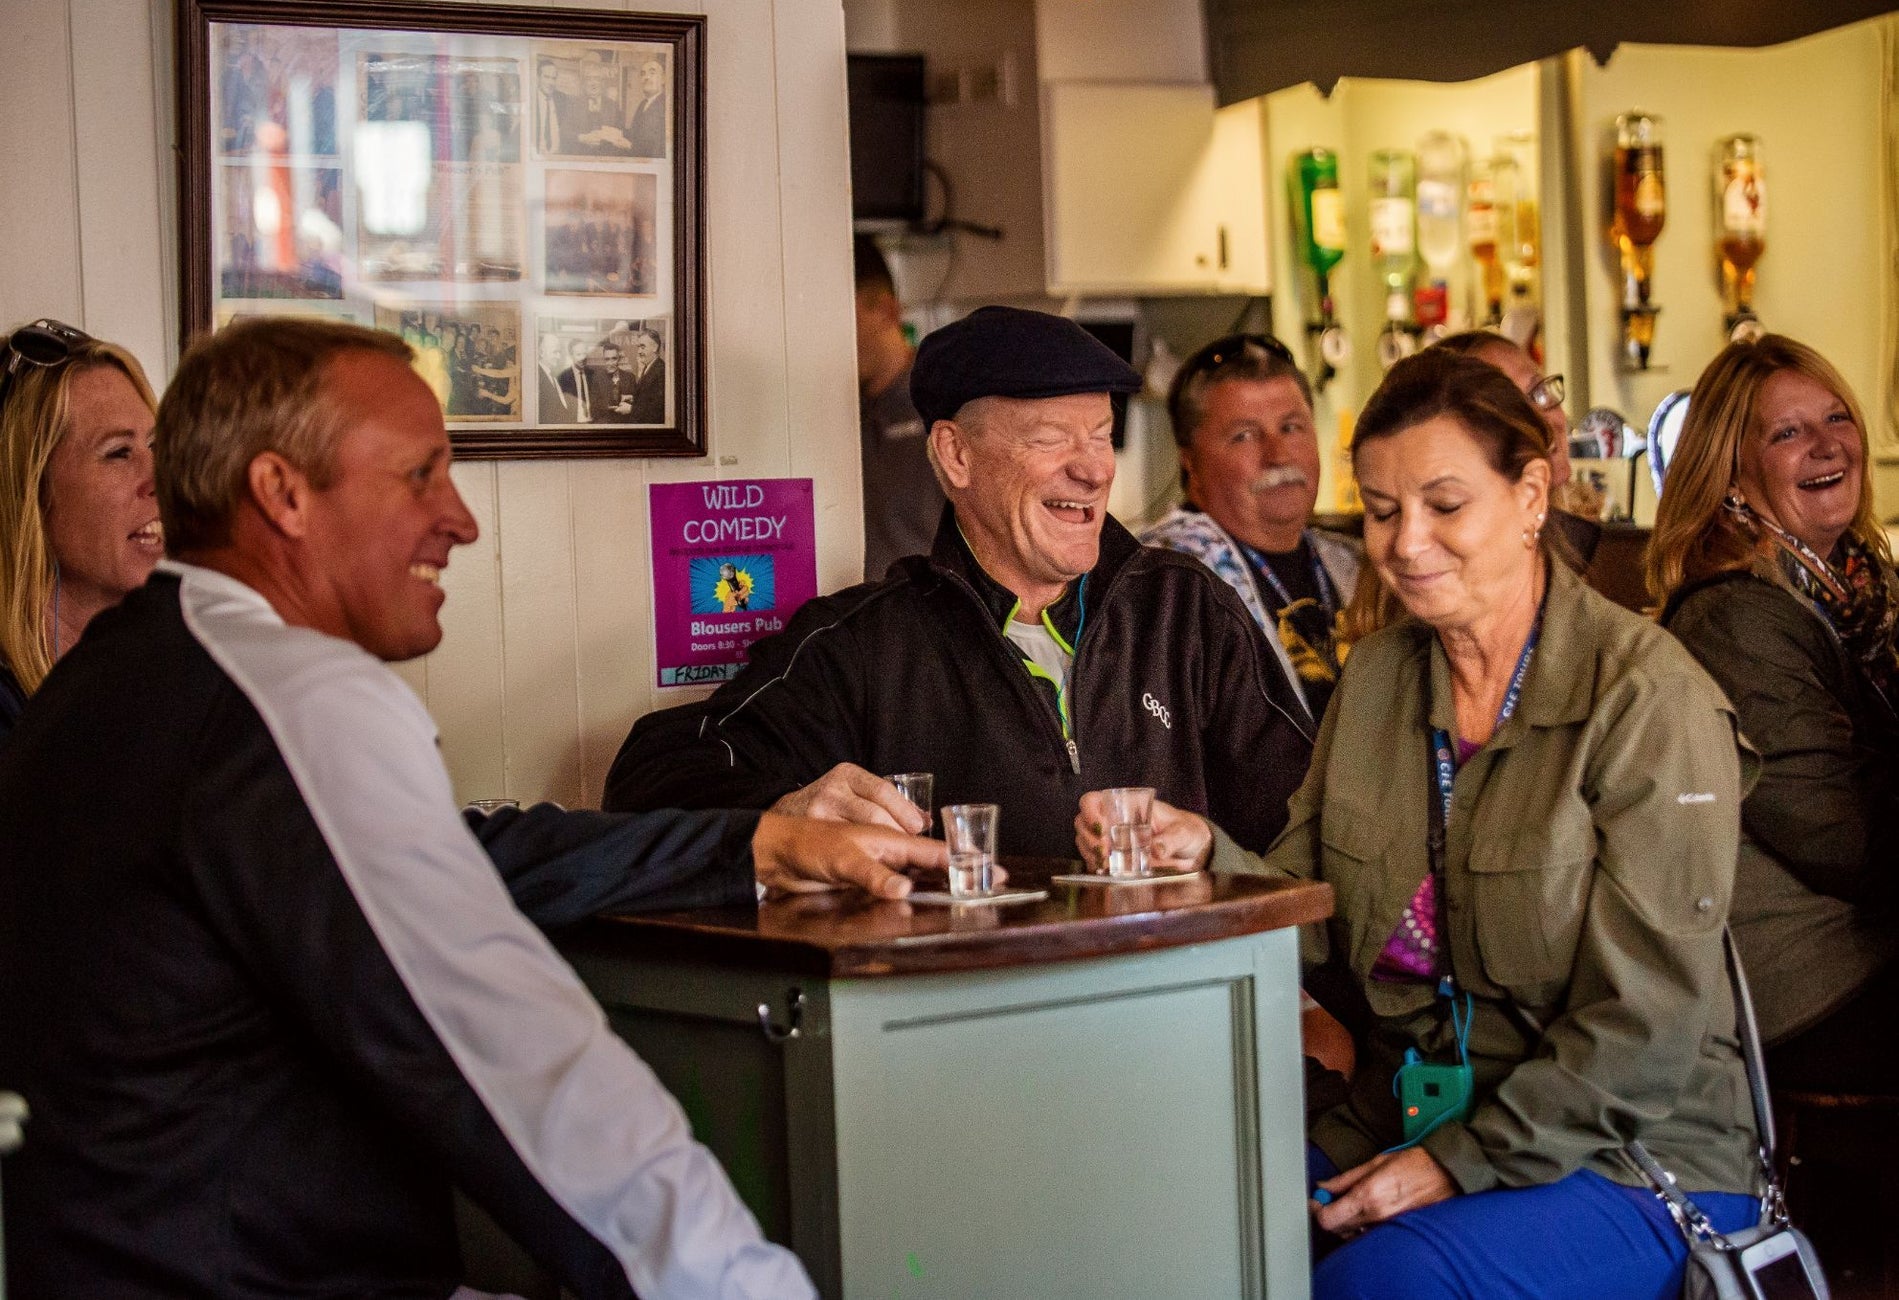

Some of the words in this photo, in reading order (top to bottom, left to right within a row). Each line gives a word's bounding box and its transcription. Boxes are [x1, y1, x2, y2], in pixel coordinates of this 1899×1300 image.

[702, 485, 764, 510] WILD
[683, 515, 786, 543] COMEDY
[691, 621, 751, 636] Blousers
[755, 617, 783, 632] Pub
[691, 642, 716, 651] Doors
[675, 664, 727, 684] FRIDAY
